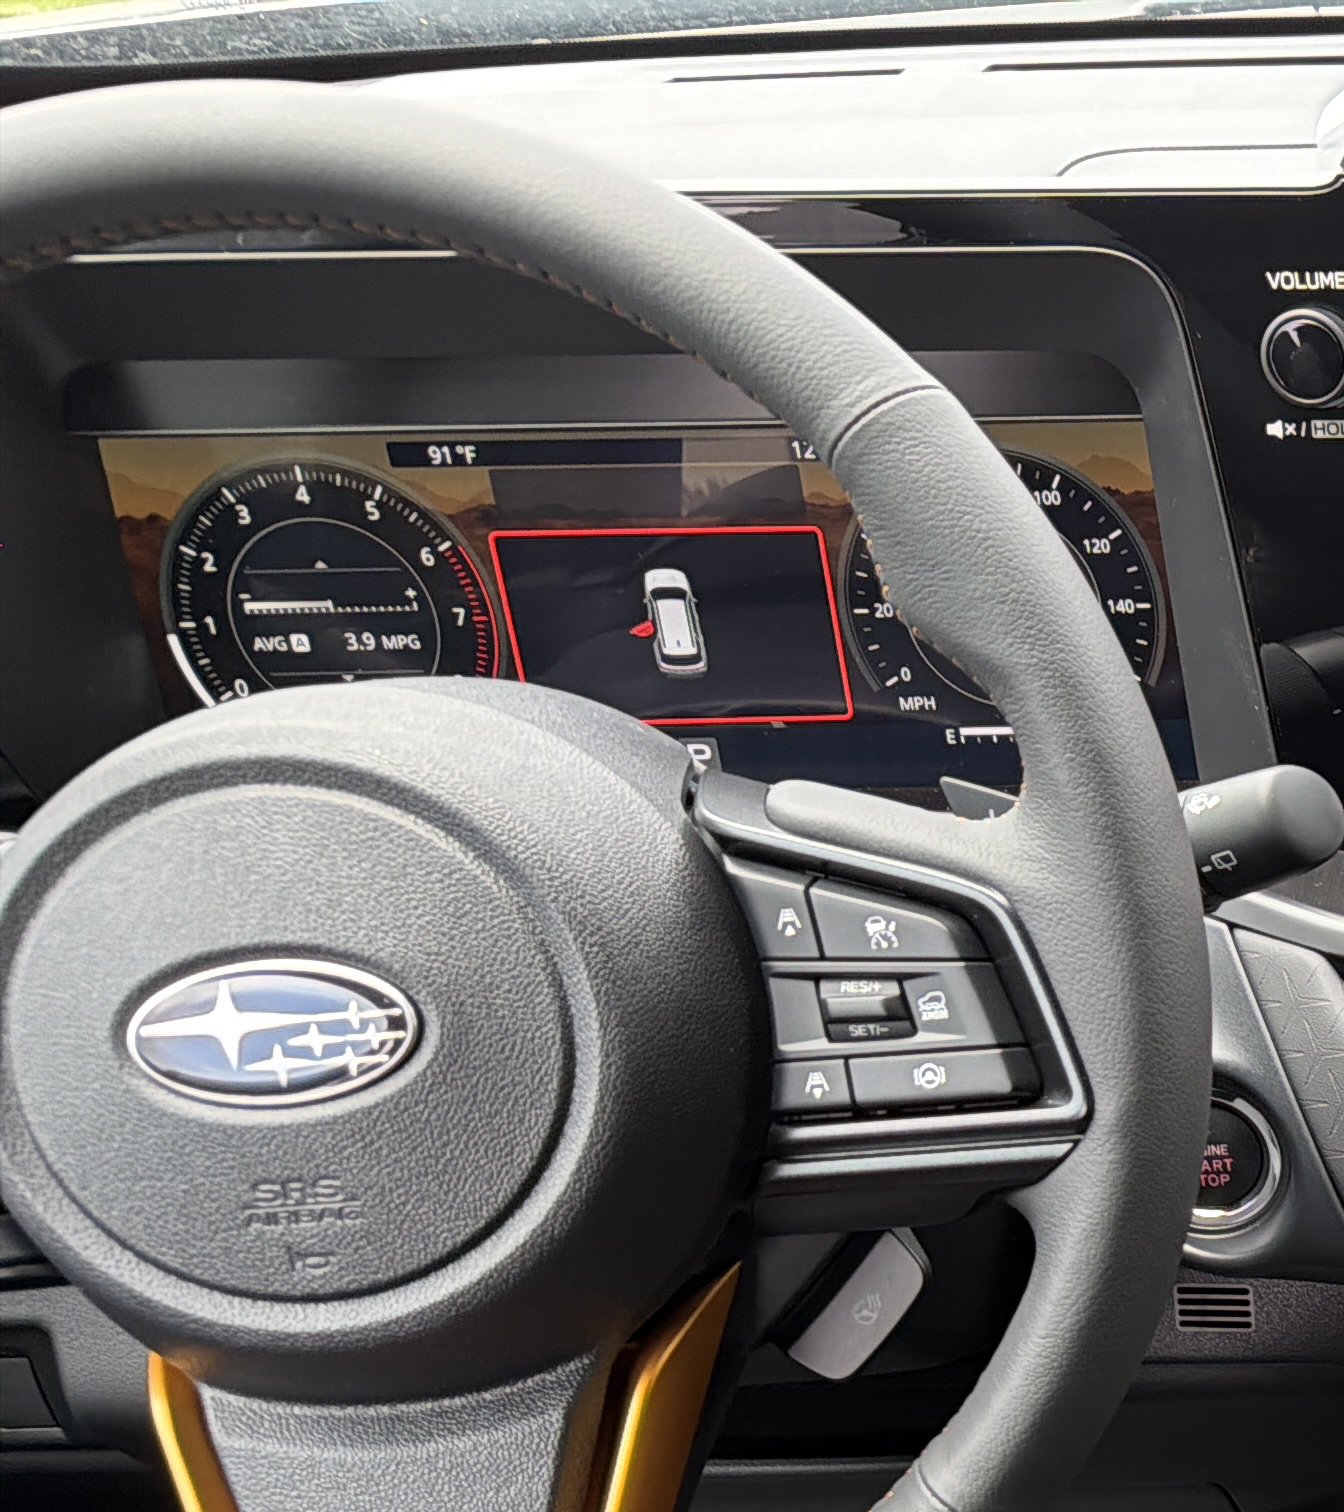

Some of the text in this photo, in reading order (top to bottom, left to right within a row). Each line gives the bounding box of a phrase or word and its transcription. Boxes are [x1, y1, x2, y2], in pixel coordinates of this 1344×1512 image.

[295, 485, 310, 504] 4
[1033, 490, 1061, 506] 100
[234, 504, 251, 525] 3
[364, 500, 380, 521] 5
[1083, 538, 1111, 554] 120
[200, 552, 218, 573] 2
[419, 546, 435, 567] 6
[874, 603, 894, 619] 20
[1107, 598, 1135, 614] 140
[203, 615, 217, 635] 1
[451, 607, 465, 627] 7
[253, 635, 288, 652] AVG
[344, 632, 376, 650] 3.9
[381, 634, 421, 650] MPG
[900, 668, 912, 682] 0
[235, 678, 249, 697] 0
[899, 696, 937, 711] MPH
[945, 729, 955, 744] E
[686, 743, 712, 770] P
[1203, 1144, 1229, 1156] INE
[1201, 1158, 1233, 1172] ART
[1200, 1173, 1230, 1187] TOP
